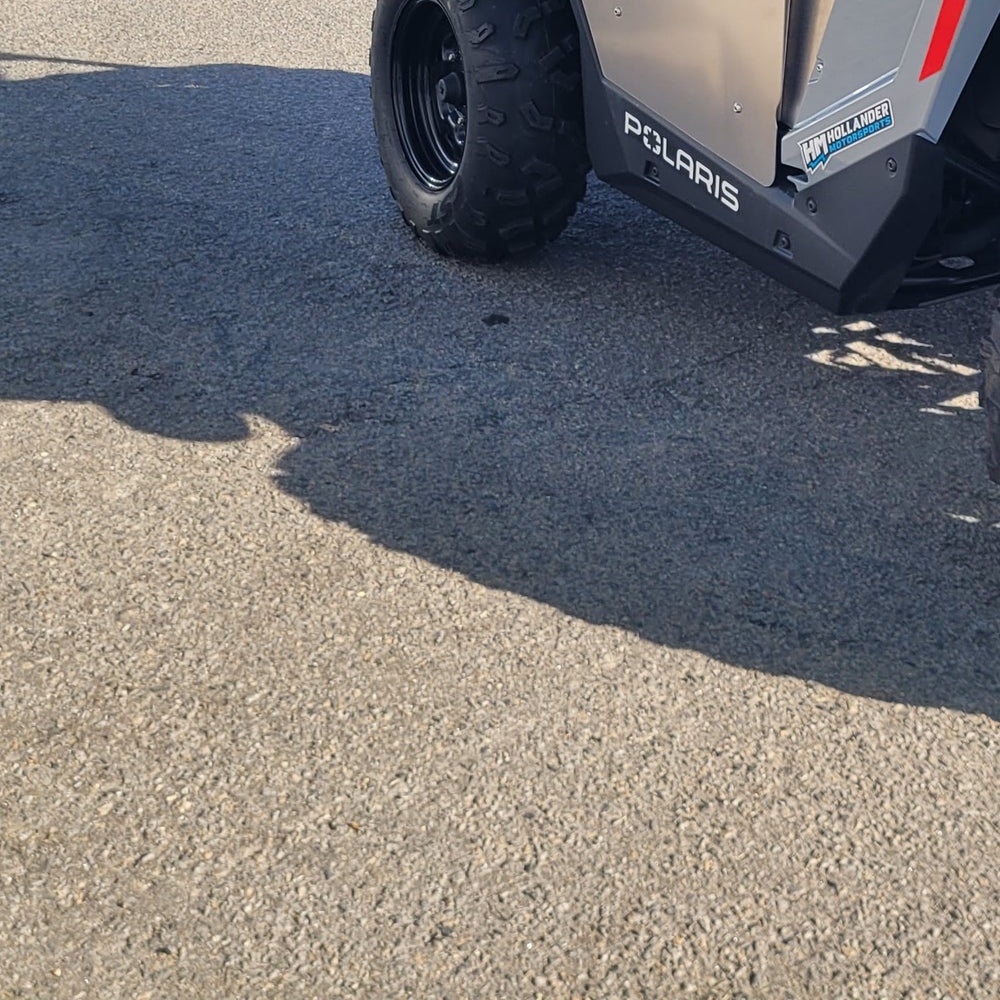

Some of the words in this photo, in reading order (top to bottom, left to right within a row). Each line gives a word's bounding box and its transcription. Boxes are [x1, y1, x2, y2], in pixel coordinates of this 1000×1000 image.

[827, 102, 890, 145] HOLLANDER
[829, 116, 891, 153] MOTORSPORTS
[624, 111, 739, 212] POLARIS
[802, 133, 829, 165] HM
